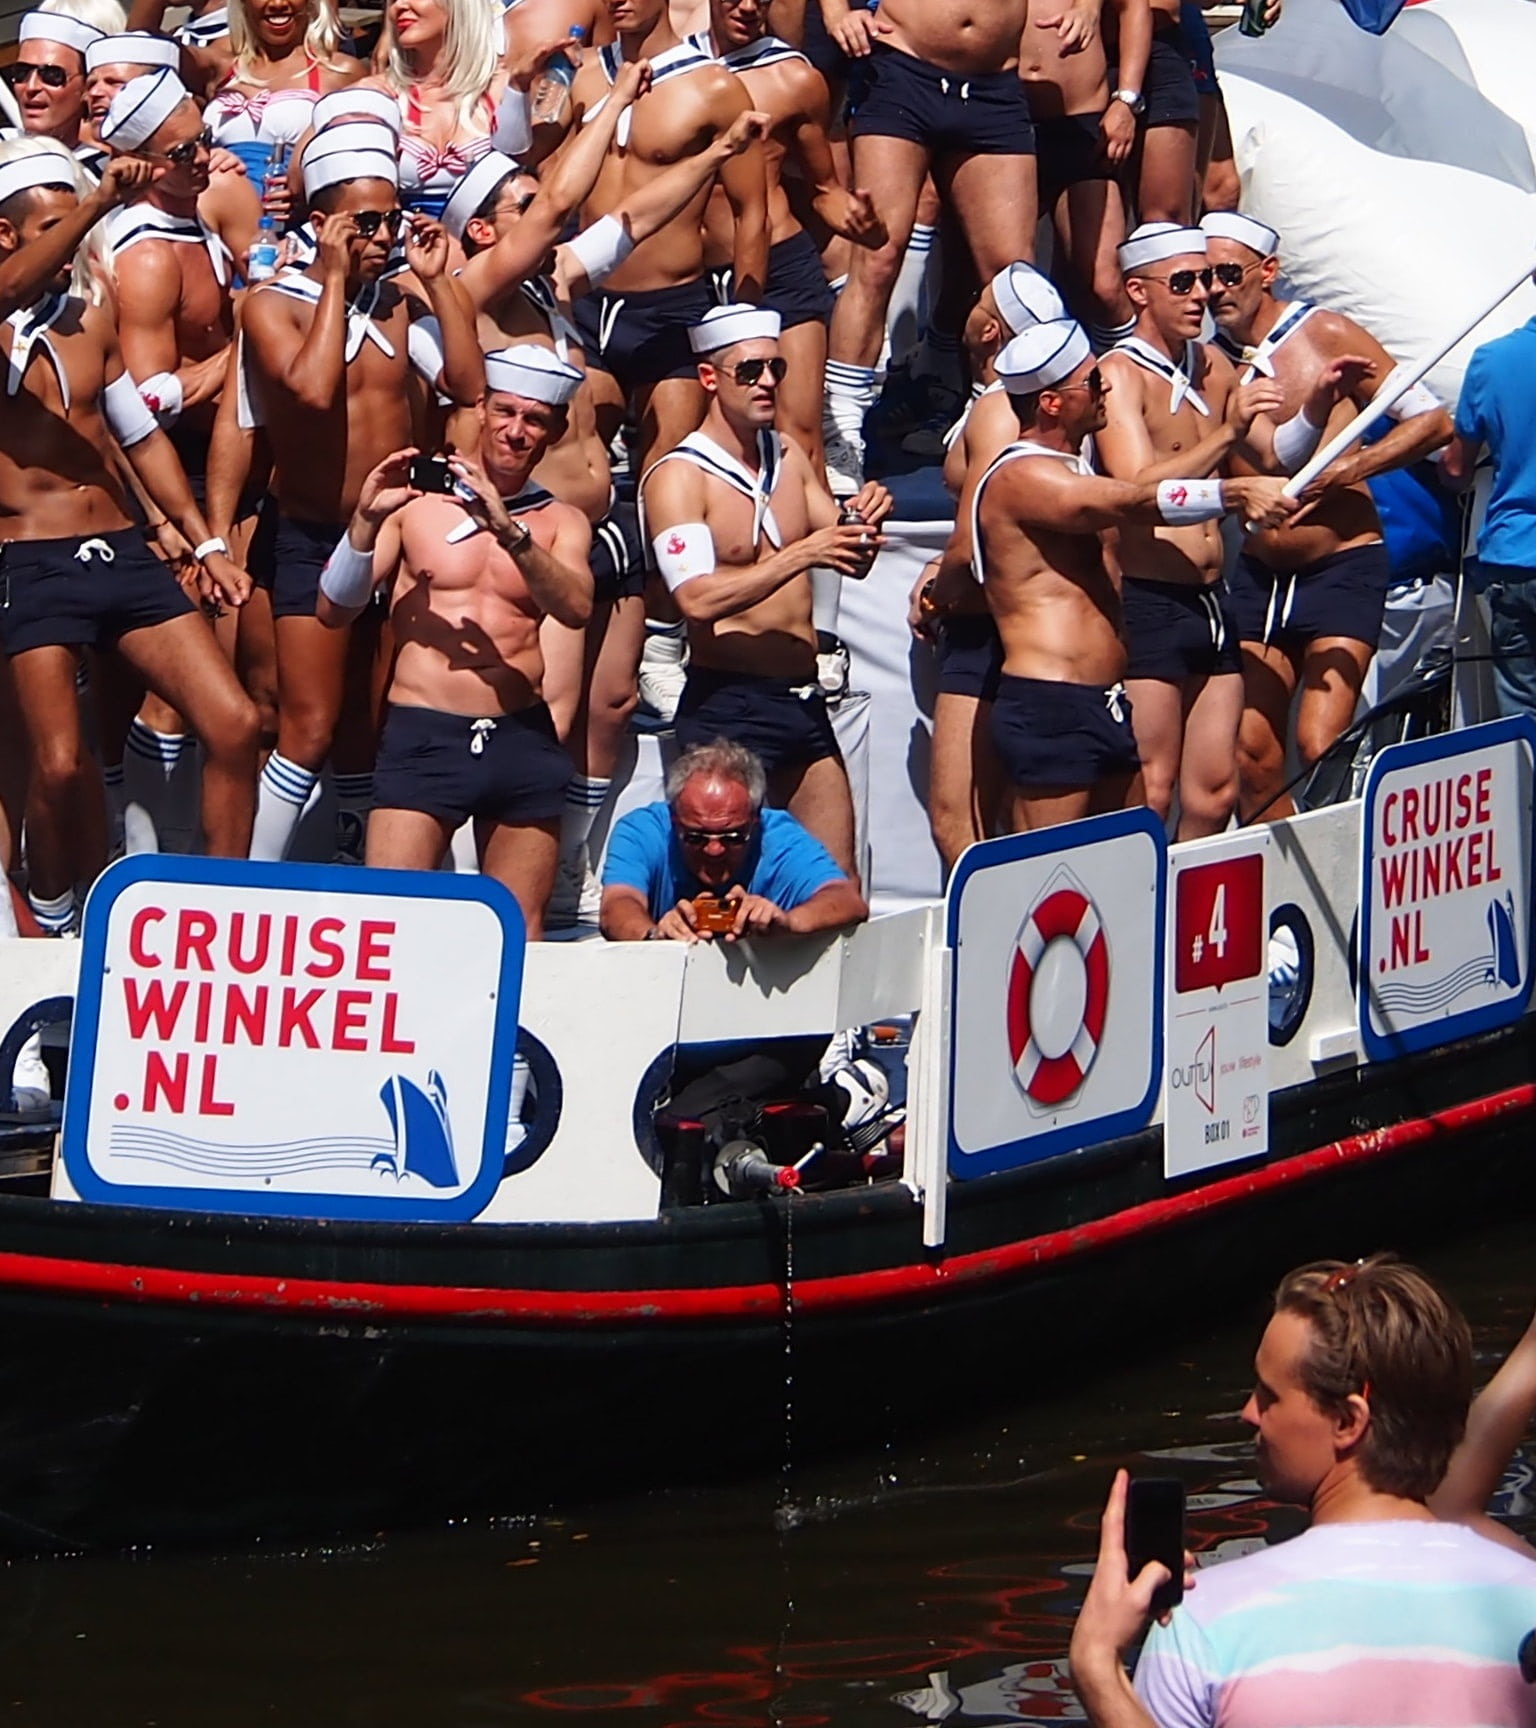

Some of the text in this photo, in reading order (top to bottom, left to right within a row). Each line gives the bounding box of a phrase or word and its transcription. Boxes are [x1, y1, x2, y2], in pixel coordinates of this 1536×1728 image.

[1382, 768, 1492, 847] CRUISE
[1380, 829, 1501, 909] WINKEL
[128, 906, 396, 981] CRUISE
[1379, 910, 1430, 974] .NL
[123, 978, 415, 1054] WINKEL
[114, 1050, 234, 1116] .NL
[1205, 1122, 1220, 1145] BOX
[1221, 1120, 1231, 1140] 01
